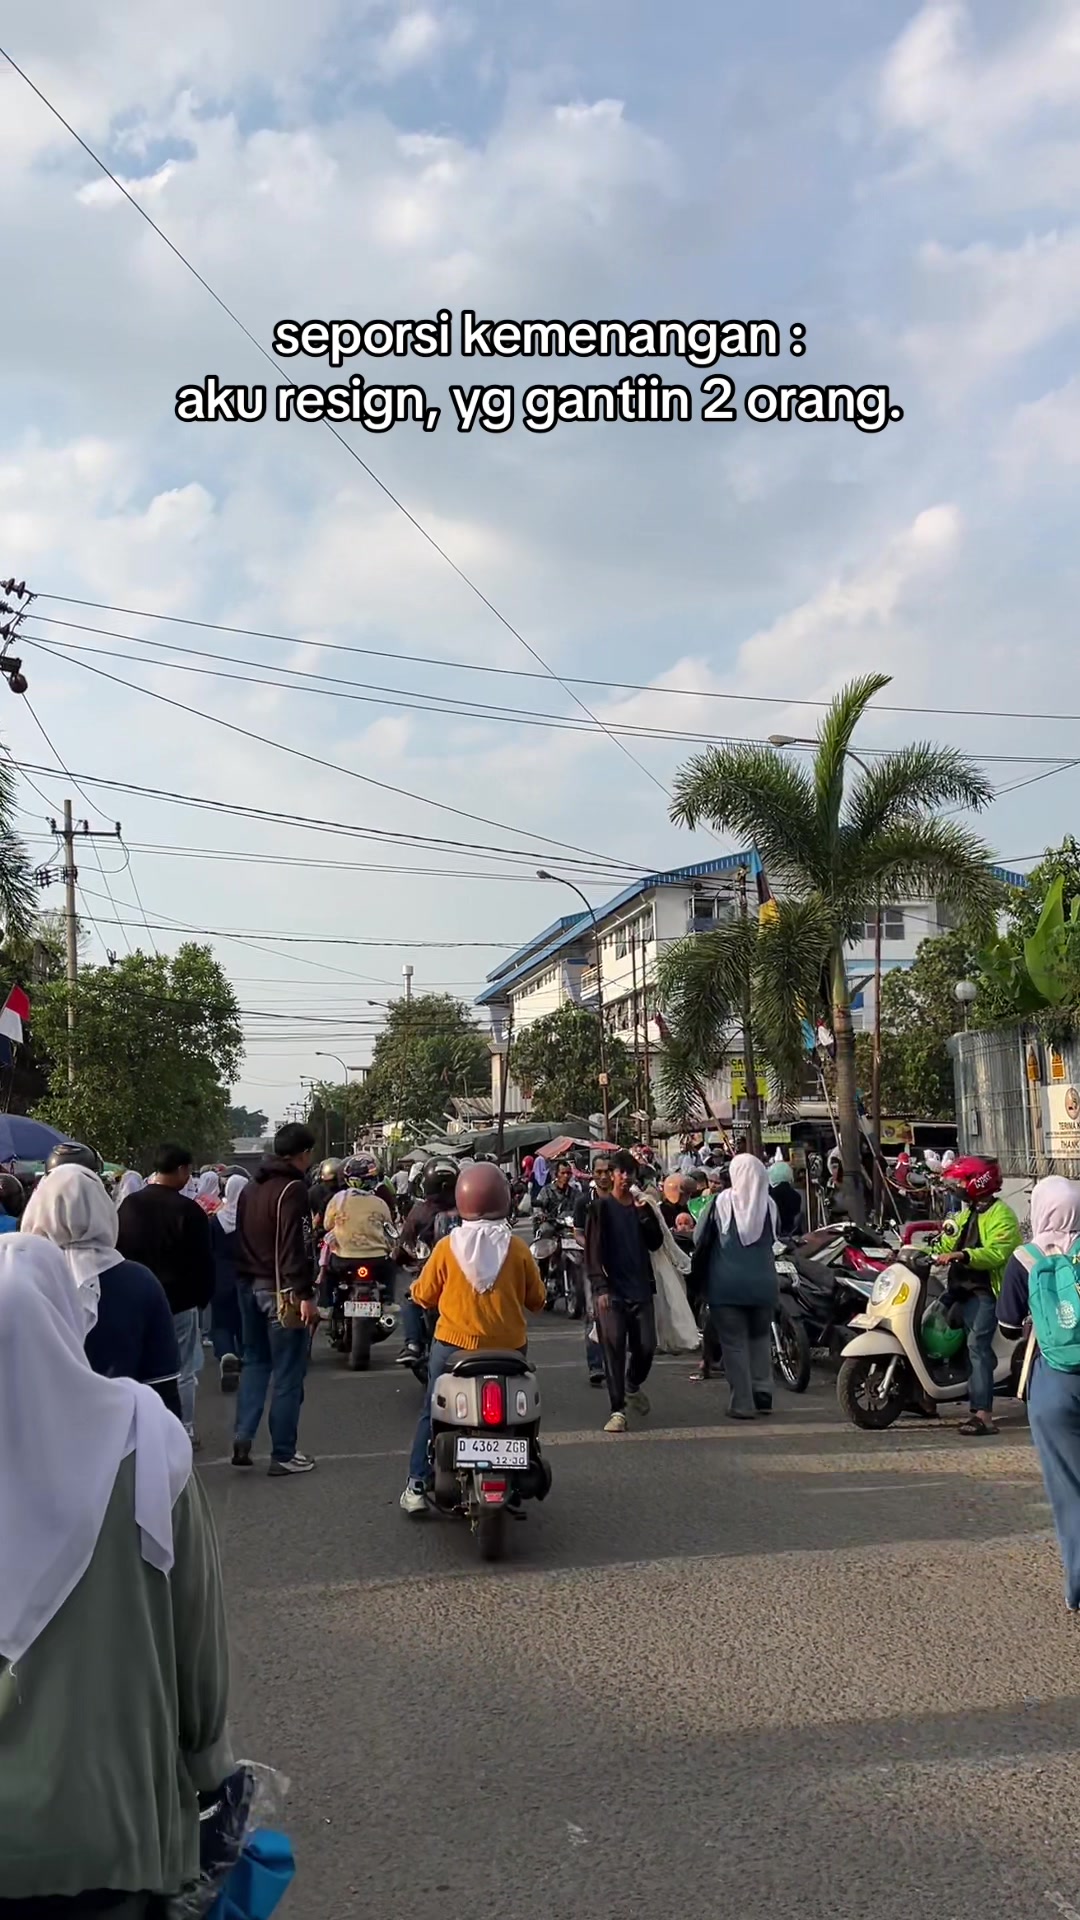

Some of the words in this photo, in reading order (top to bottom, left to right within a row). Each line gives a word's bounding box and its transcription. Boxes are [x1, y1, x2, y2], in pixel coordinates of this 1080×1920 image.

[459, 1440, 466, 1452] D
[472, 1440, 499, 1452] 4362
[505, 1441, 526, 1453] ZGB
